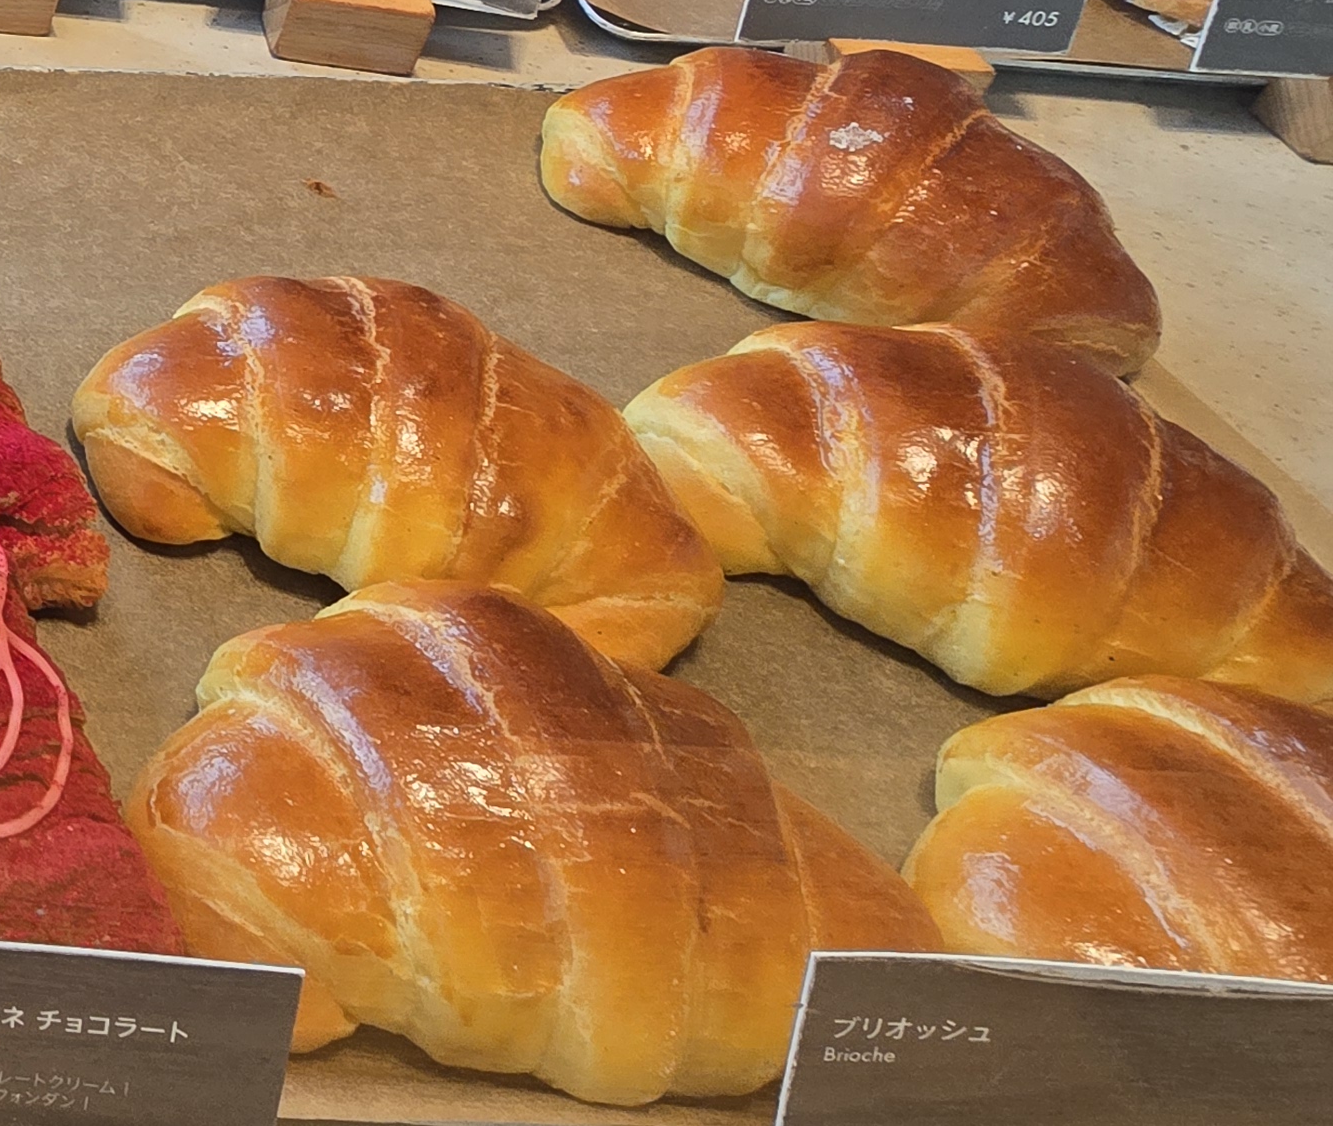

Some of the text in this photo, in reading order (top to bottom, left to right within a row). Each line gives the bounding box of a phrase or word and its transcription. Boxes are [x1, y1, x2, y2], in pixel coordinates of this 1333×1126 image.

[1002, 10, 1060, 28] ¥405
[36, 1009, 191, 1044] チョコラート
[832, 1016, 992, 1044] ブリオッシュ
[822, 1045, 896, 1064] Brioche
